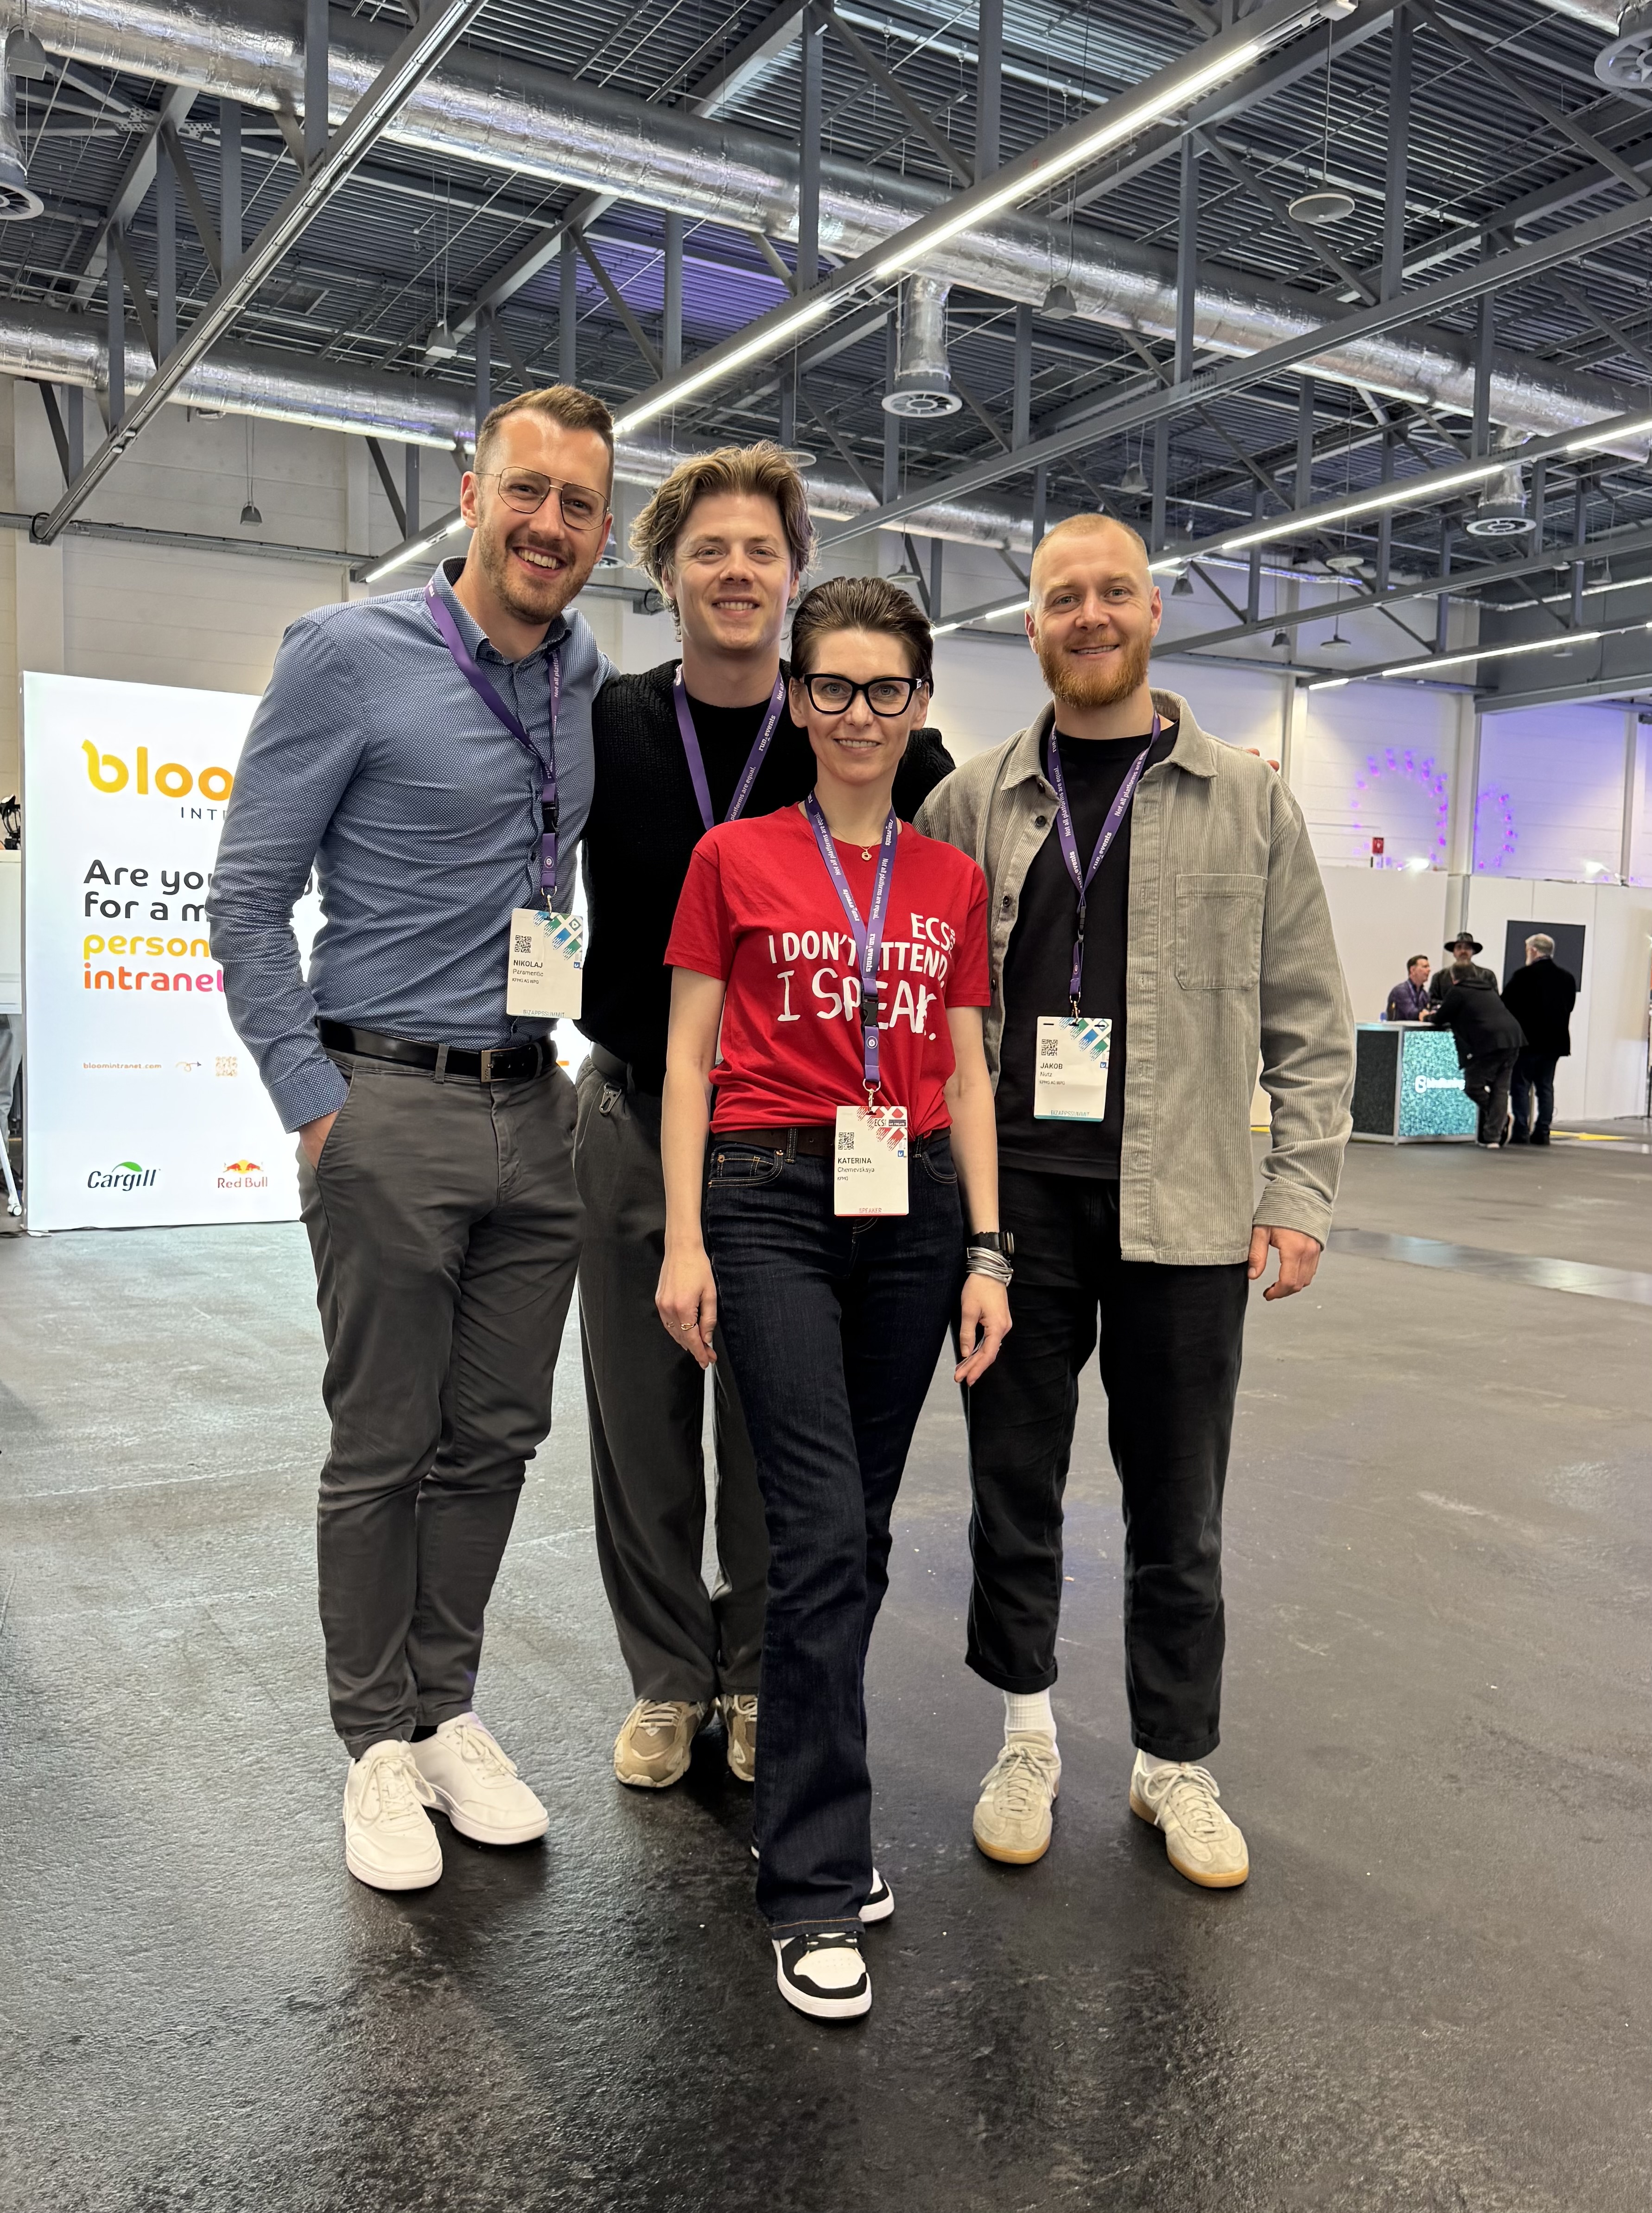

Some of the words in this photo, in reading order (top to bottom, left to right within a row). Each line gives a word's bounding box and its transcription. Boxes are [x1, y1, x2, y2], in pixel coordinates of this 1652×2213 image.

[1114, 806, 1124, 817] Not
[1124, 771, 1138, 798] platforms
[83, 859, 148, 887] Are
[85, 891, 139, 918] for
[150, 902, 168, 921] a
[911, 912, 950, 951] ECS
[513, 960, 543, 968] NIKOLAJ
[768, 935, 777, 964] I
[877, 941, 948, 988] TTEND.
[777, 970, 801, 1022] I
[88, 1169, 157, 1191] Cargill
[217, 1177, 241, 1188] Red
[245, 1176, 267, 1188] Bull
